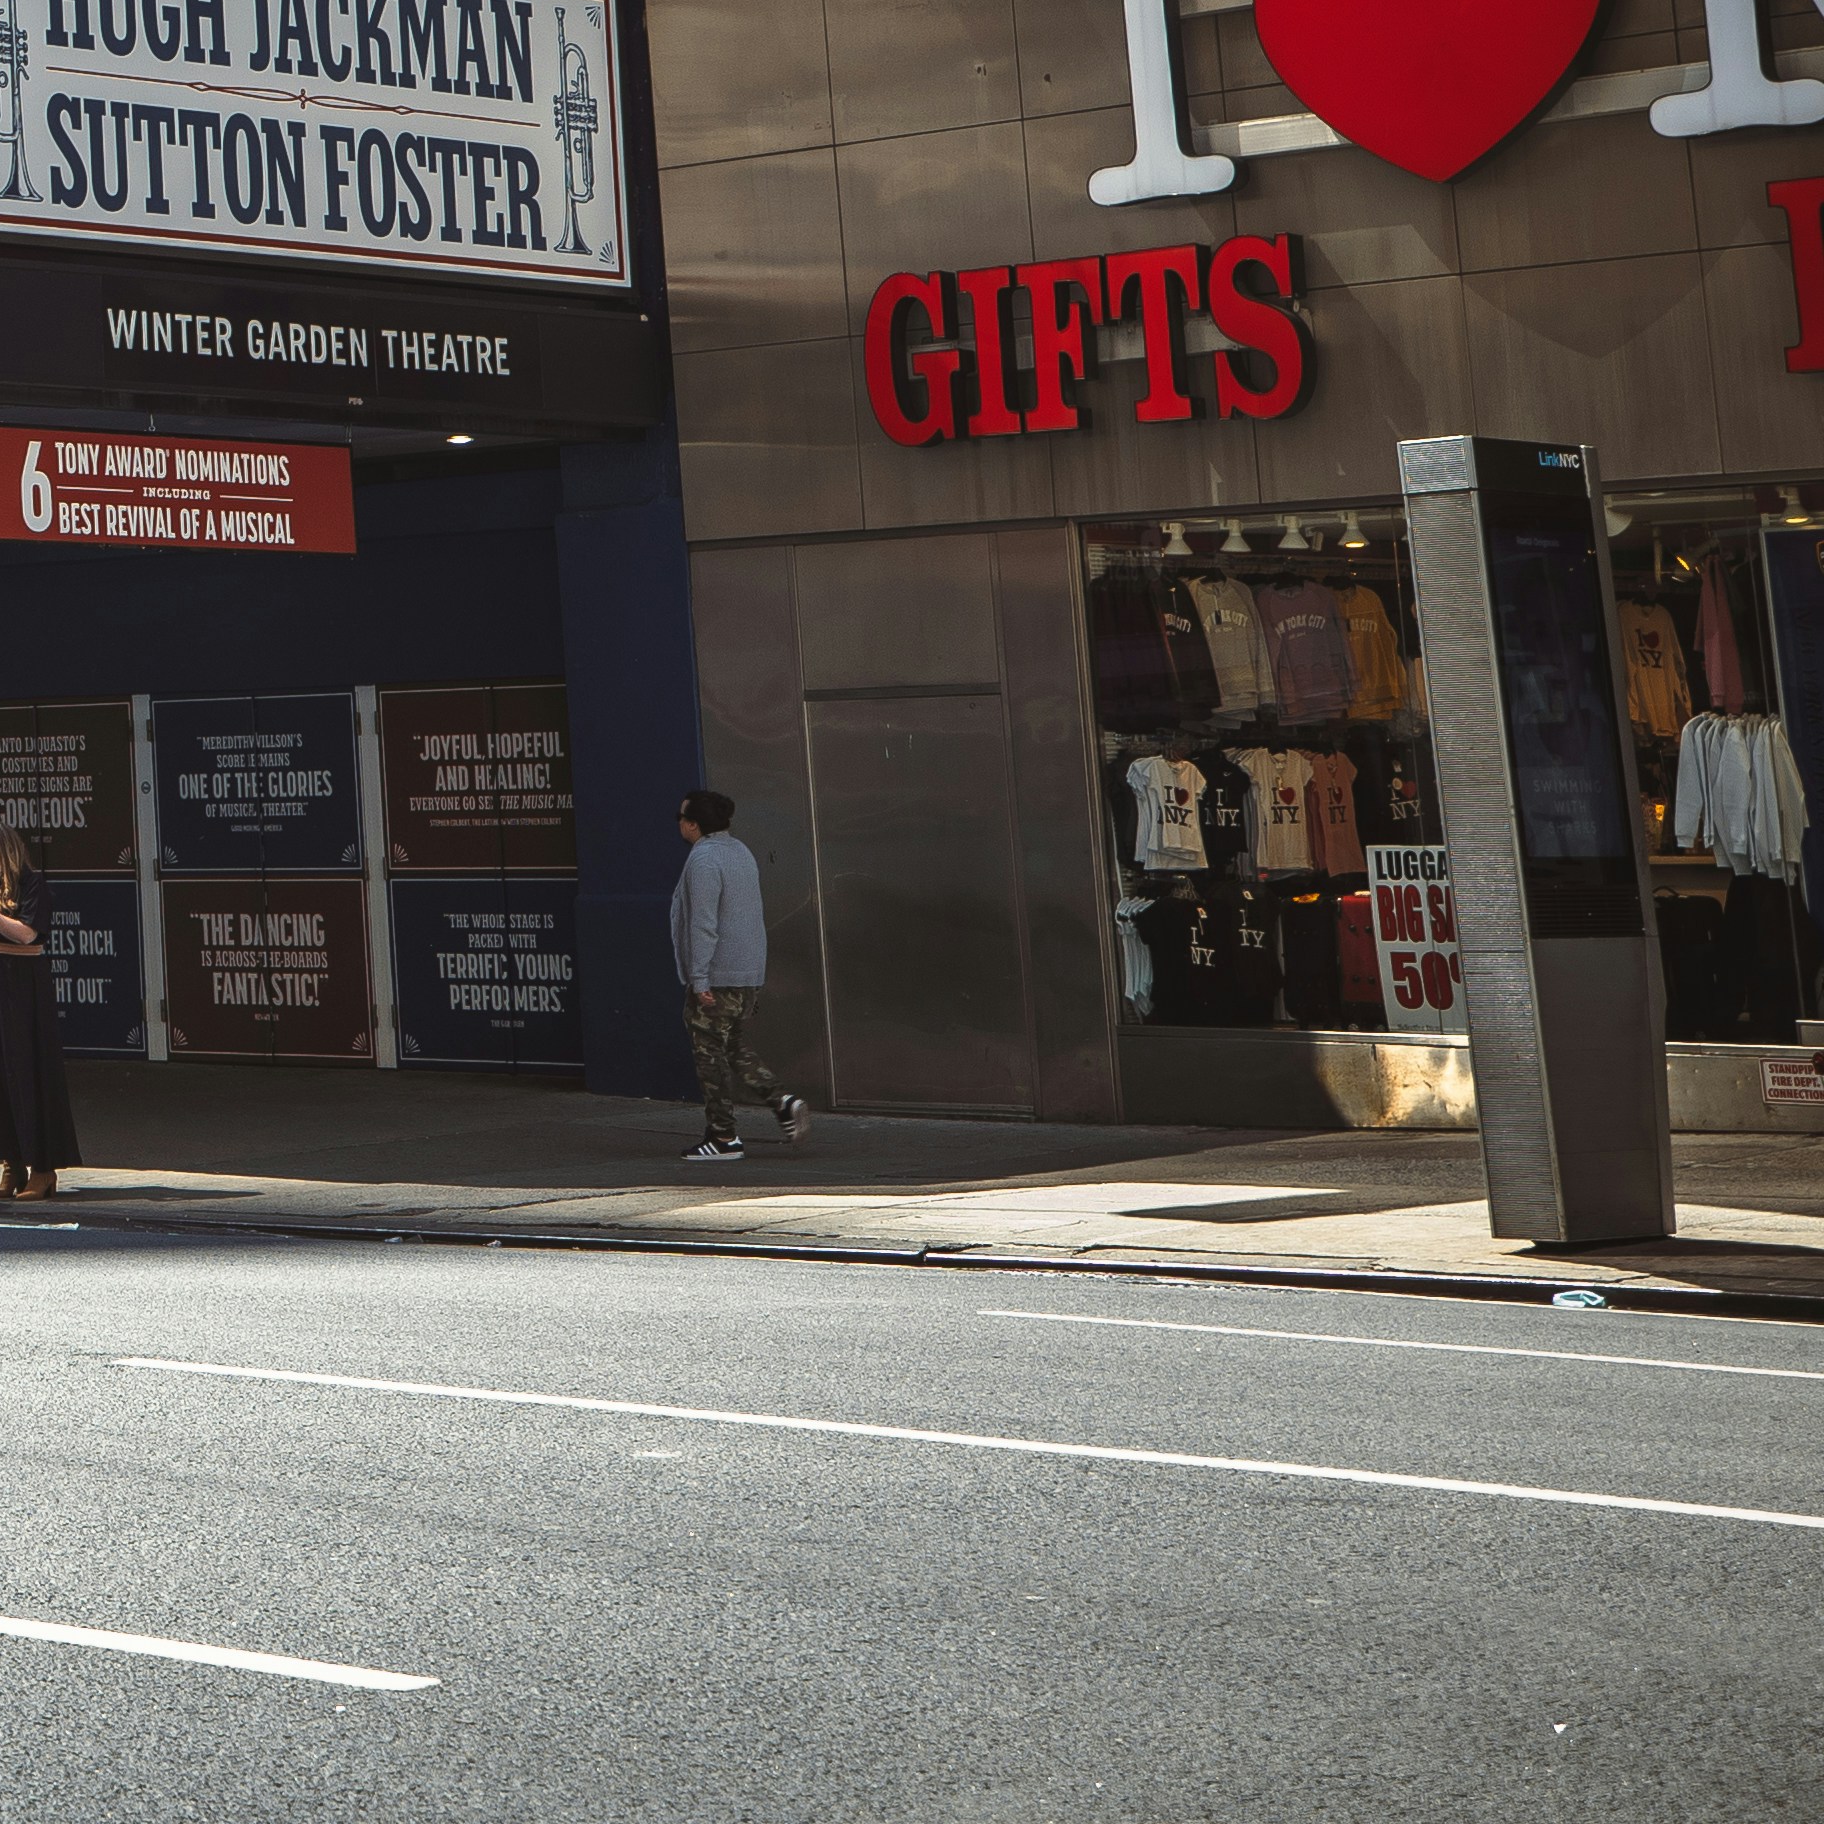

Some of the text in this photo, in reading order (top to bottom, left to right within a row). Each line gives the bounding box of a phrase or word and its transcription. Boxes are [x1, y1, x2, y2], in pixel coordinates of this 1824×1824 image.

[46, 92, 547, 252] SUTTON FOSTER
[106, 307, 511, 376] WINTER GARDEN THEATRE
[865, 231, 1306, 448] GIFTS
[1538, 452, 1579, 468] LinkNYC
[21, 441, 52, 532] 6
[55, 442, 100, 475] TONY
[175, 449, 290, 486] NOMINATIONS
[142, 487, 211, 500] INCLUDING
[59, 503, 294, 544] BEST REVIVAL OF A MUSICAL
[57, 756, 78, 771] AND
[217, 755, 245, 768] SCORE
[73, 776, 92, 791] ARE
[179, 770, 332, 799] ONE OF GLORIES
[436, 765, 468, 791] AND
[410, 795, 553, 811] EVERYONE GO THE MUSIC
[1164, 786, 1174, 804] I
[206, 804, 218, 817] OF
[1164, 806, 1192, 826] NY
[1216, 809, 1240, 826] NY
[1271, 806, 1299, 824] NY
[1328, 807, 1346, 824] NY
[1389, 800, 1422, 820] NY
[510, 914, 553, 928] STAGE IS
[1376, 884, 1426, 943] BIG
[509, 934, 536, 948] WITH
[201, 951, 212, 966] IS
[1191, 947, 1214, 967] NY
[514, 954, 572, 981] YOUNG
[1772, 1076, 1820, 1087] FIRE DEPT.
